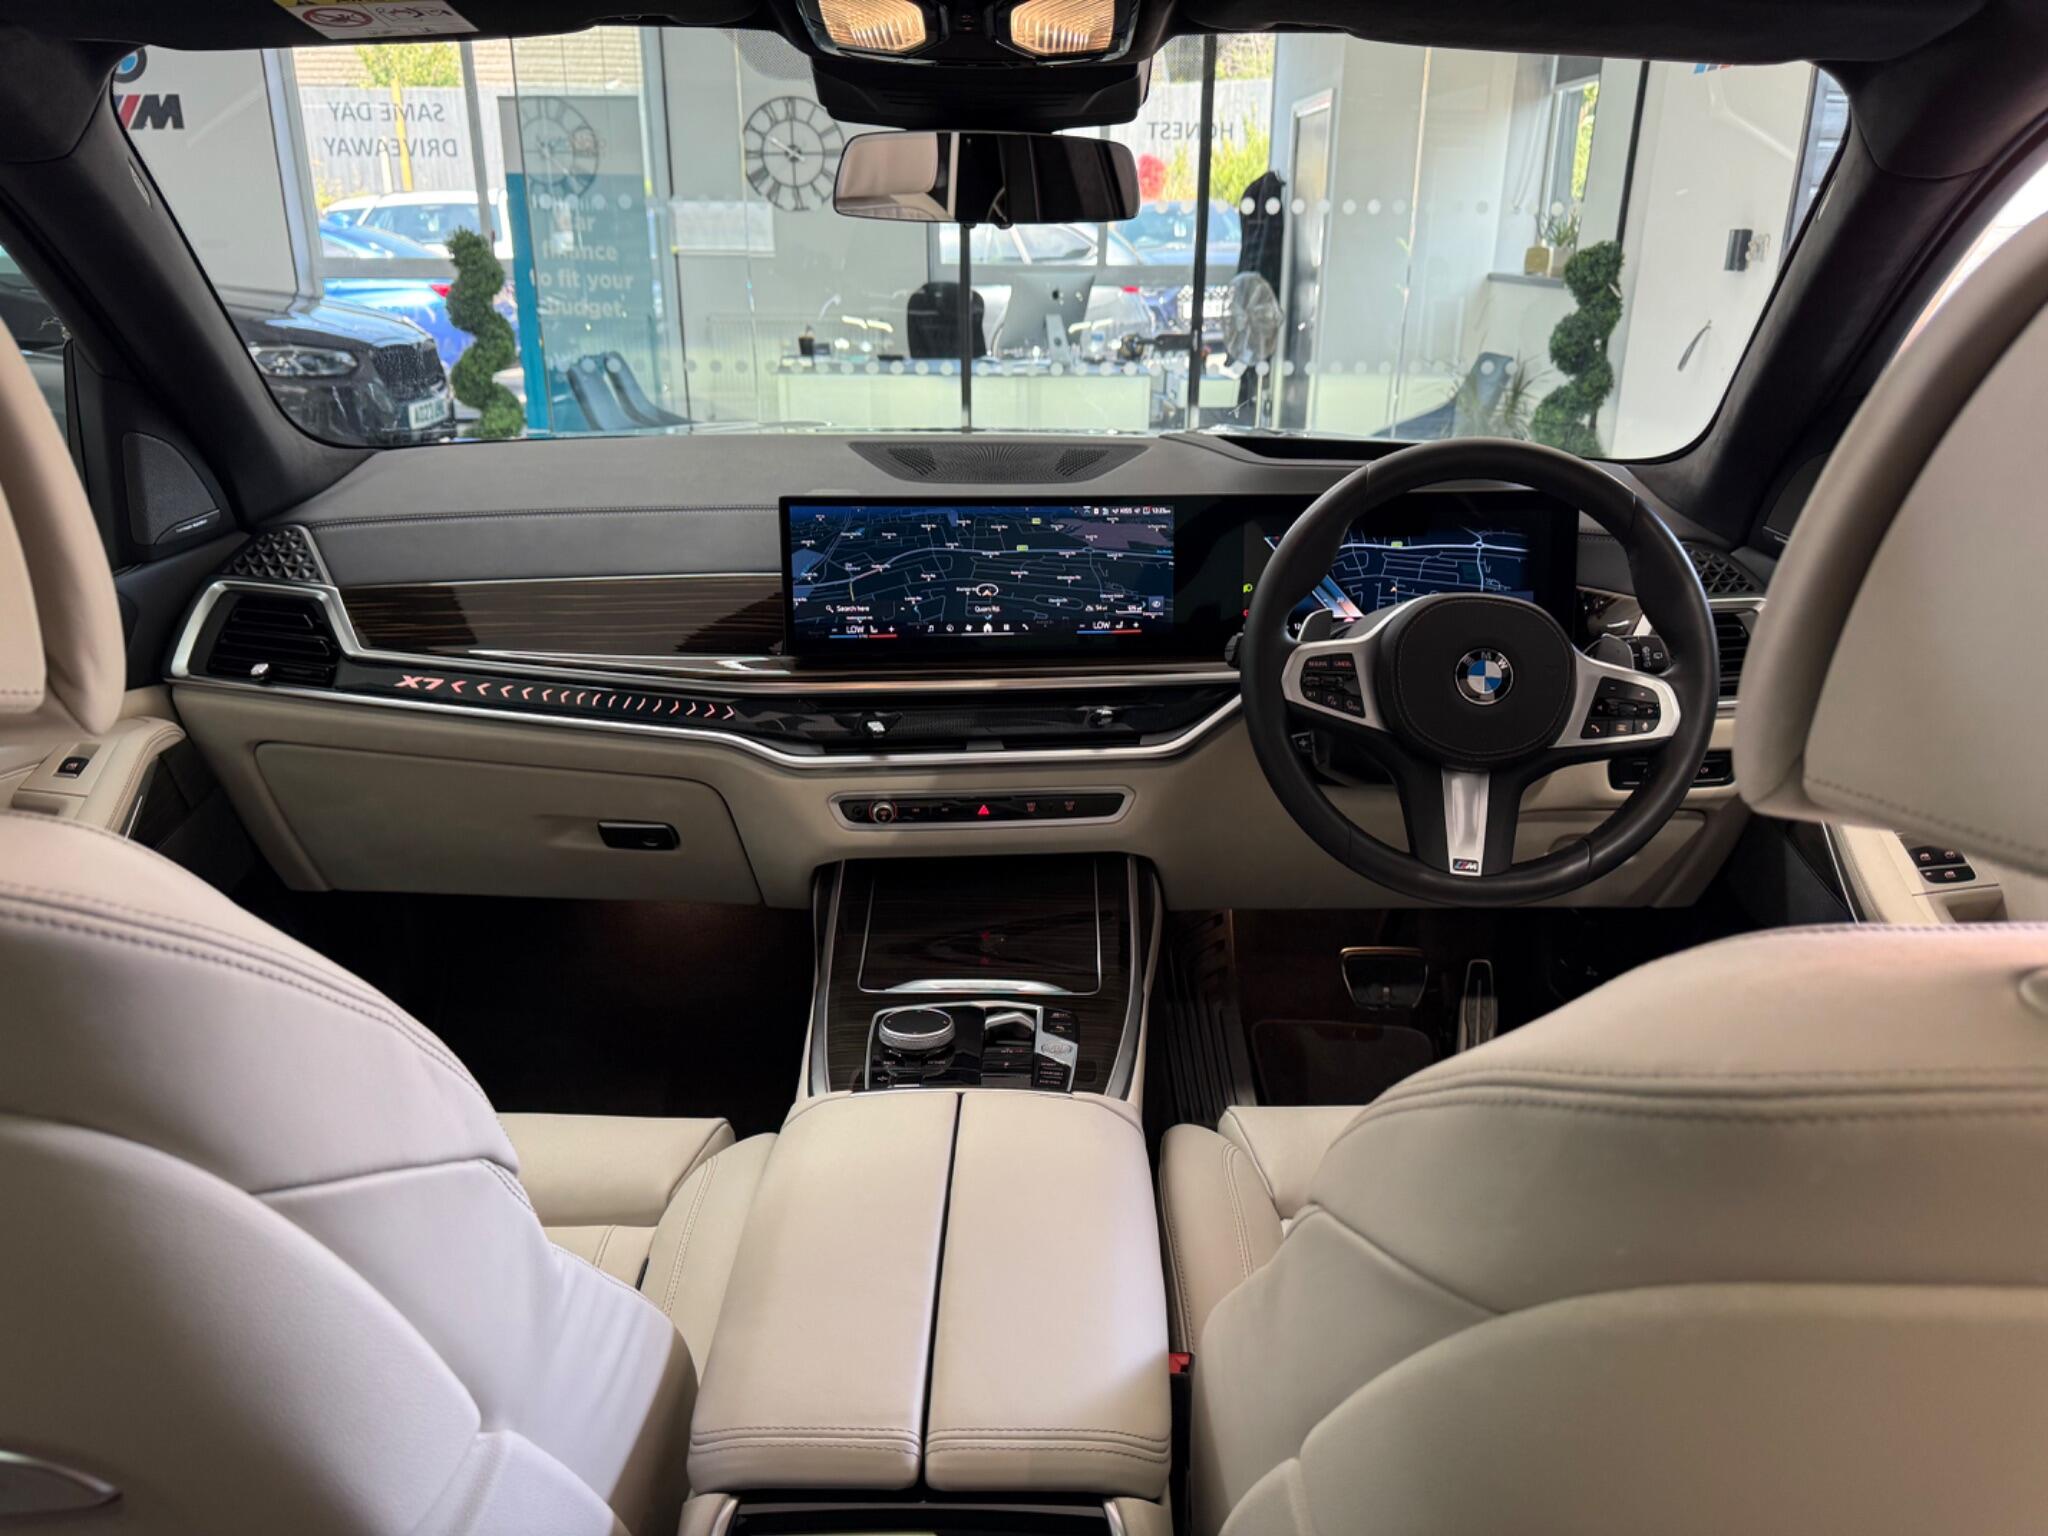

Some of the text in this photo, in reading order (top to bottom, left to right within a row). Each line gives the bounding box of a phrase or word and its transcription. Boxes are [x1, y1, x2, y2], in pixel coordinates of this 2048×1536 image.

[558, 266, 580, 289] fit
[586, 272, 635, 291] your
[836, 604, 870, 613] Search here
[846, 625, 865, 634] LOW
[1092, 621, 1111, 630] LOW
[394, 674, 444, 690] X7
